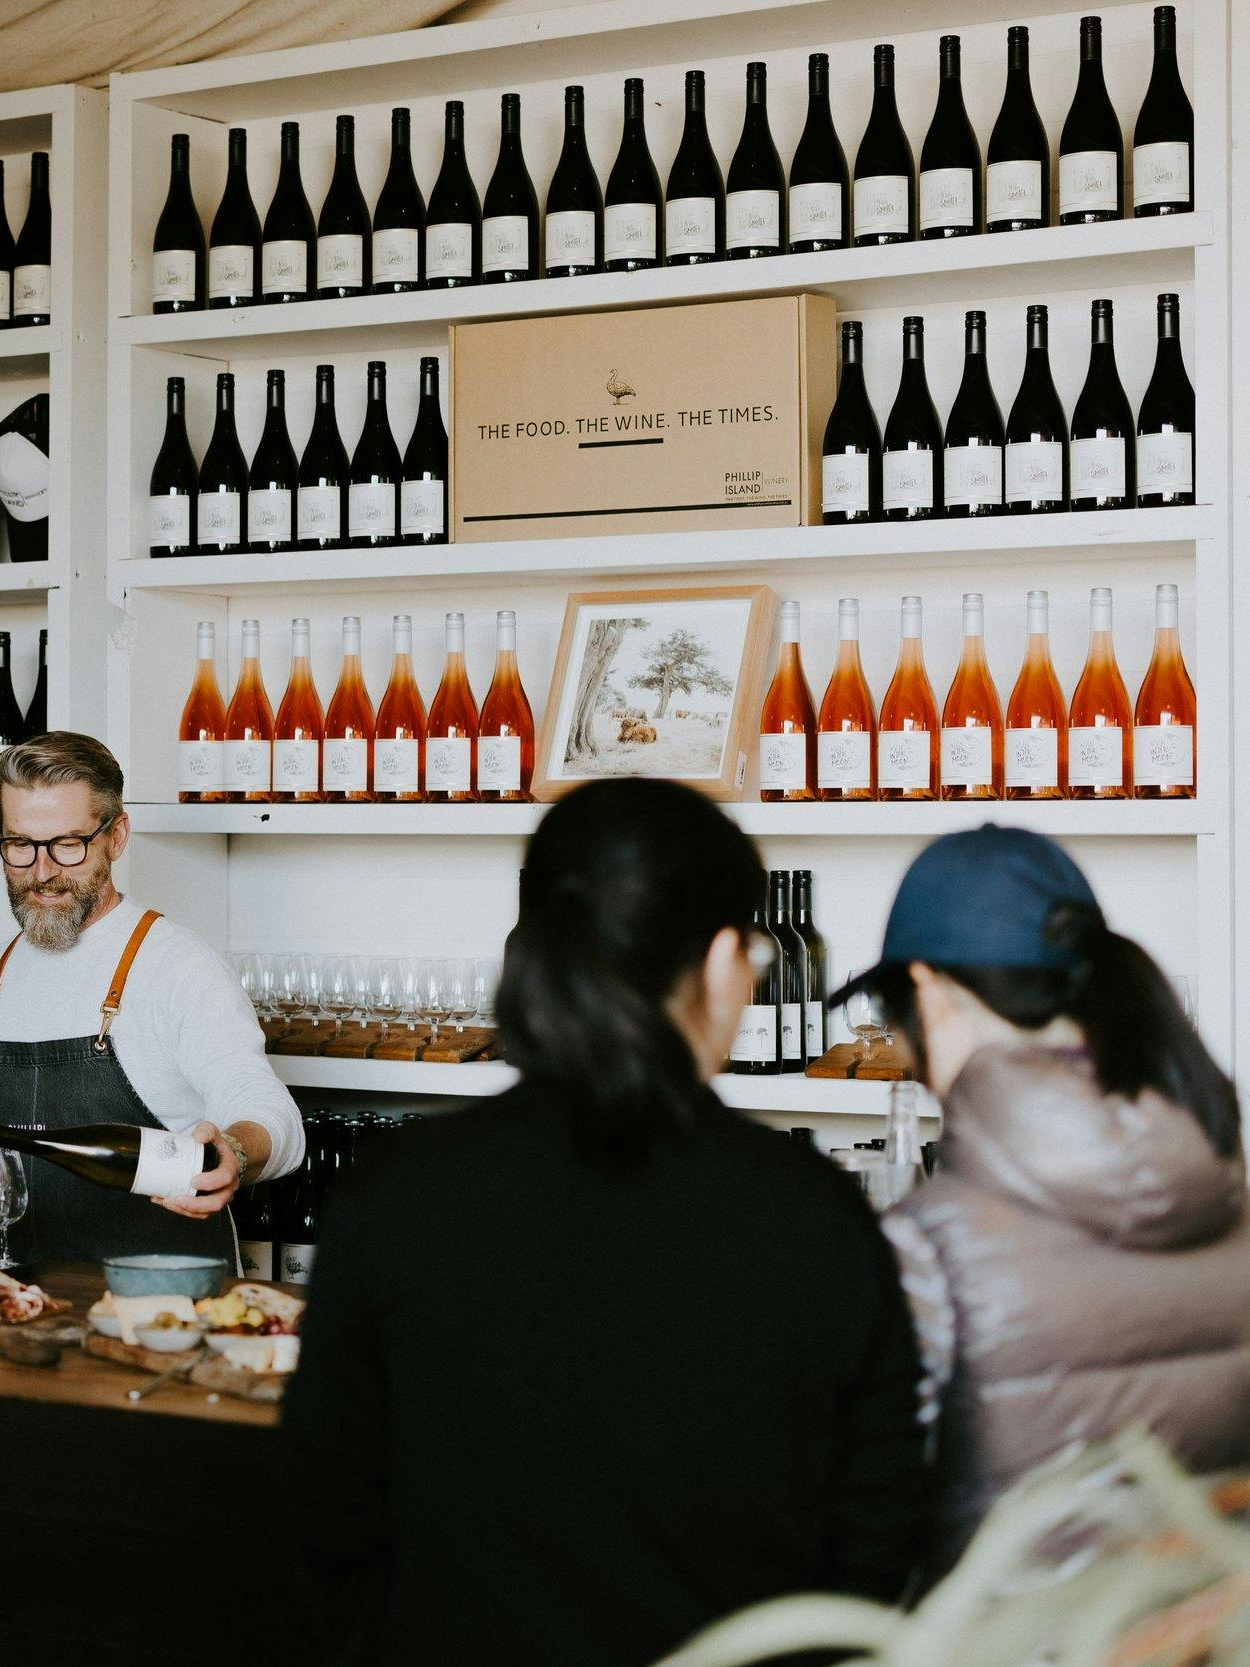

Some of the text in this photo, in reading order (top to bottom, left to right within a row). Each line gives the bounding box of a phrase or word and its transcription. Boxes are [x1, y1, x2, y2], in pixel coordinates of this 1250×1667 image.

[478, 405, 779, 440] THE FOOD. THE WINE. THE TIMES.
[725, 471, 761, 482] PHILLIP
[725, 484, 761, 495] ISLAND
